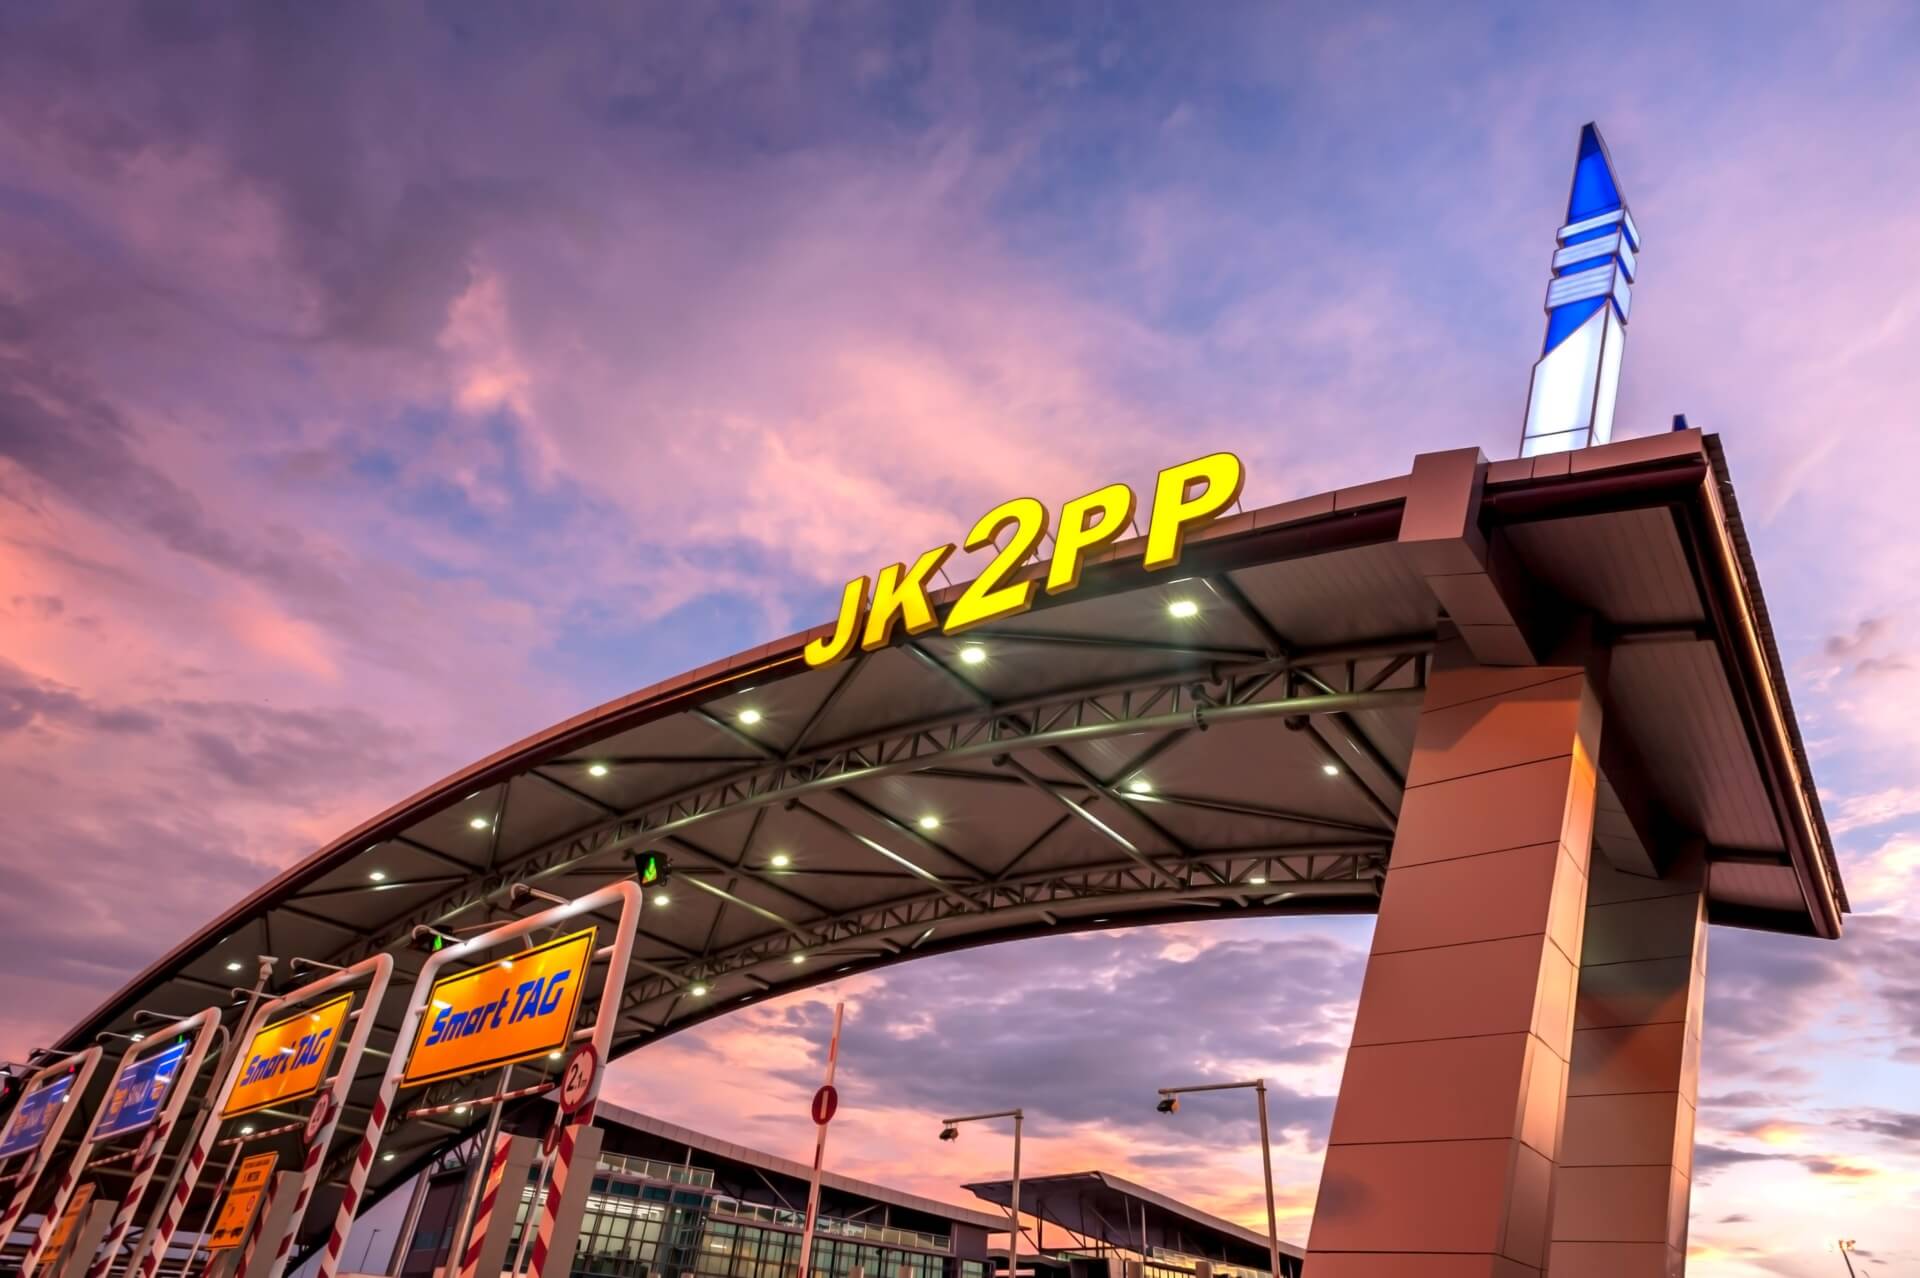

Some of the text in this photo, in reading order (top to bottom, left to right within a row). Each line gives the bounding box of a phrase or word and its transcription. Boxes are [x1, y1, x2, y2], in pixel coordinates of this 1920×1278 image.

[804, 452, 1245, 668] JK2PP
[425, 969, 572, 1047] Smart TAG
[240, 1027, 333, 1087] Smart TAG
